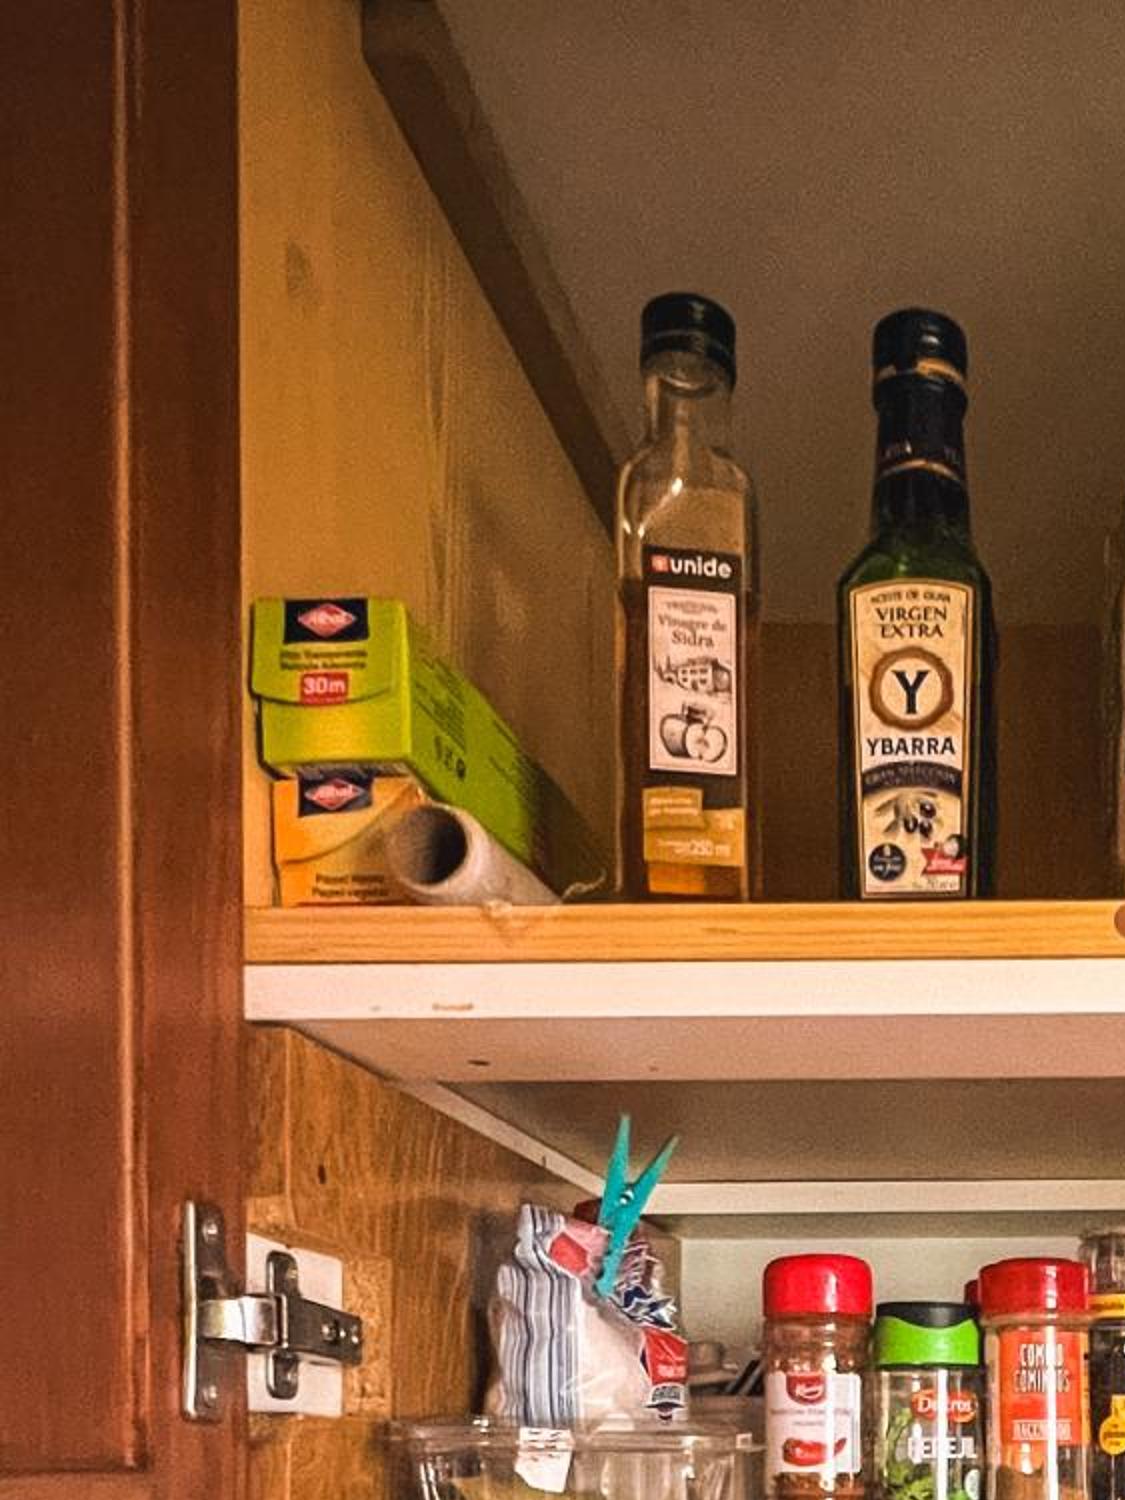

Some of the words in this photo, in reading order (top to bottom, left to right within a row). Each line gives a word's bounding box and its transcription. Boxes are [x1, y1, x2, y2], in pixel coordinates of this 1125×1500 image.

[670, 556, 733, 579] unide
[875, 606, 947, 621] VIRGEN
[671, 630, 715, 649] Sidra
[881, 623, 944, 639] EXTRA
[892, 670, 929, 714] Y
[866, 738, 956, 757] YBARRA
[1020, 1343, 1064, 1367] COMO
[1013, 1369, 1070, 1393] COMINOS
